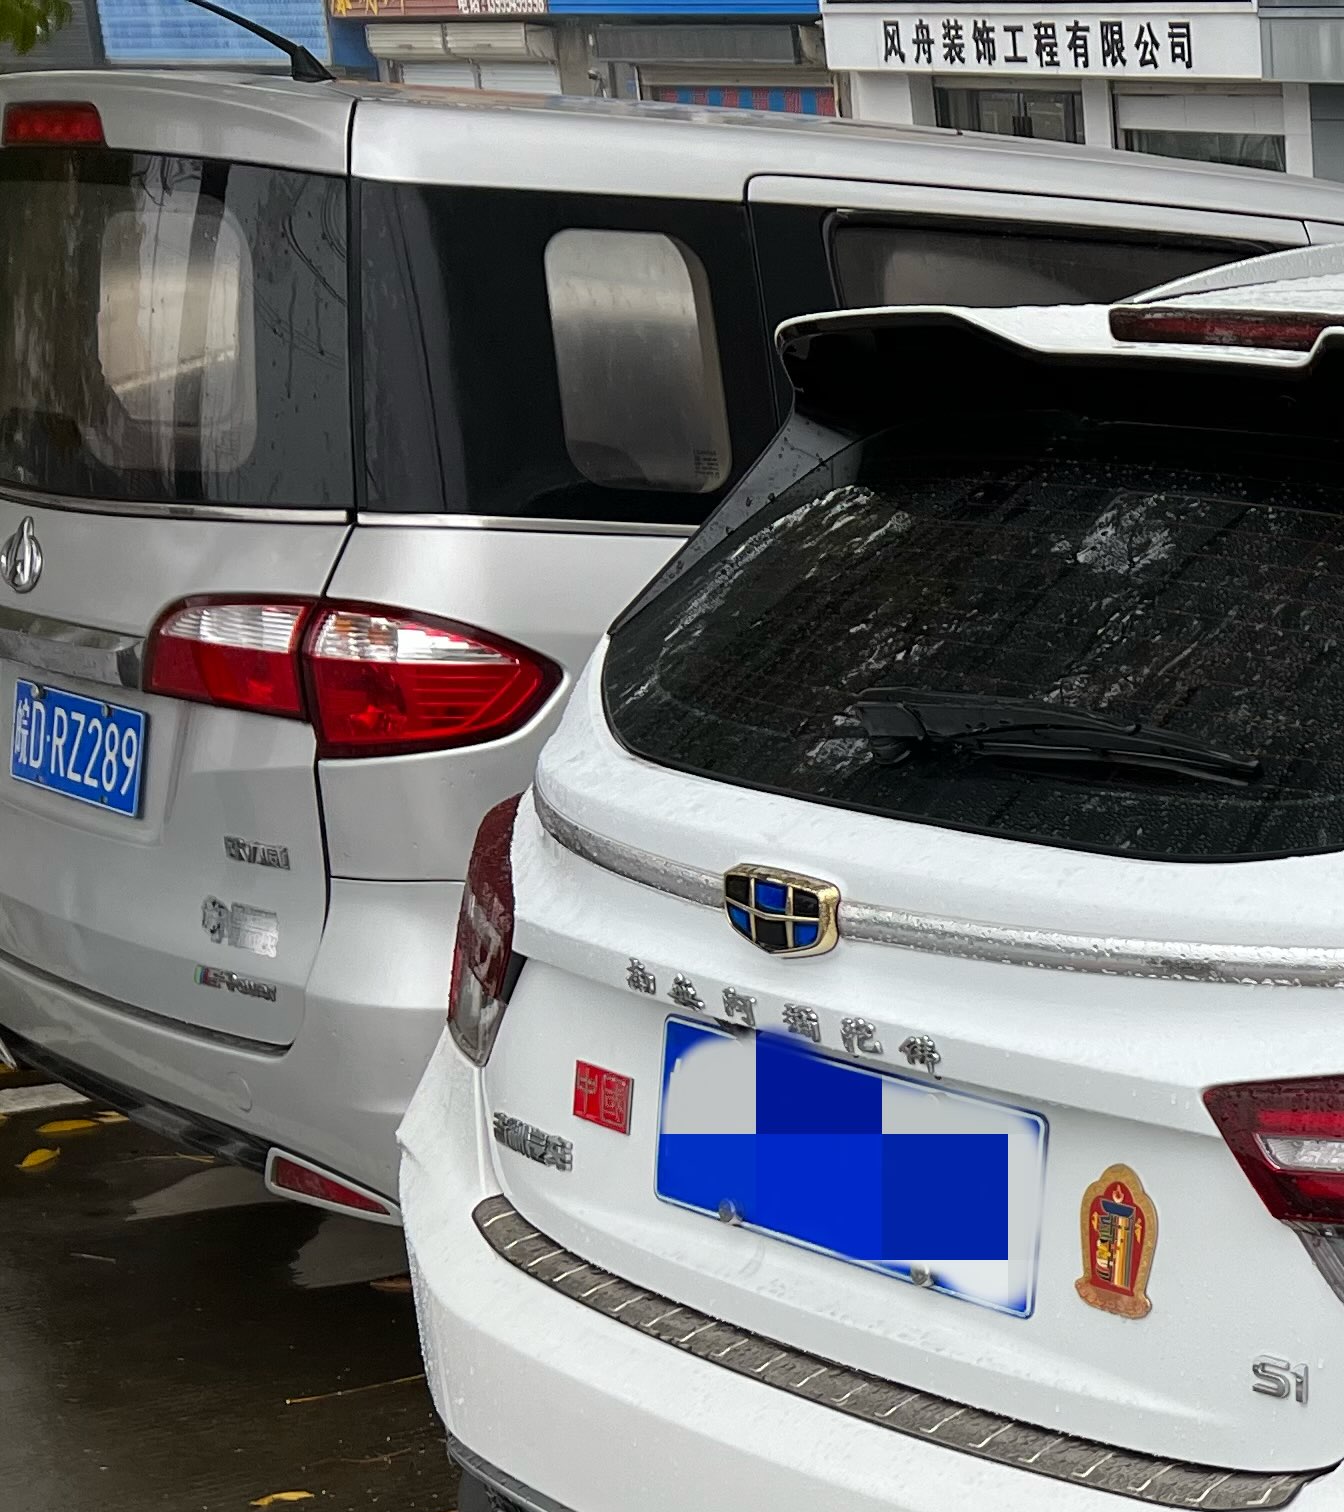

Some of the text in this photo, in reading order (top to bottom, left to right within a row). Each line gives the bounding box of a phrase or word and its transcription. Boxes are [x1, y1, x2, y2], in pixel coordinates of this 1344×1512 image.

[882, 19, 1194, 70] 风舟装饰工程有限公司
[1252, 1354, 1309, 1405] S1
